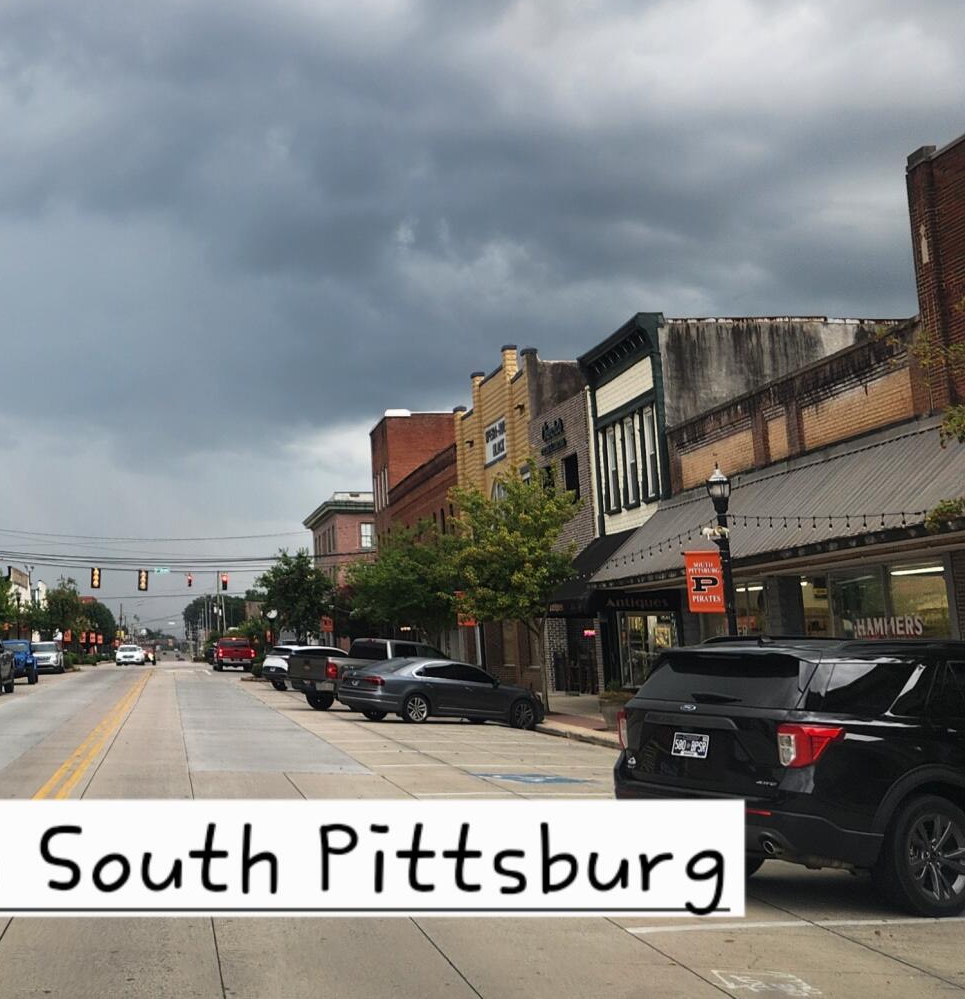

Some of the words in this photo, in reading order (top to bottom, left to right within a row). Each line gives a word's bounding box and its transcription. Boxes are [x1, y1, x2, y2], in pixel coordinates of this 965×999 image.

[690, 576, 719, 593] P
[604, 597, 668, 608] Antiques
[692, 595, 721, 603] PIRATES
